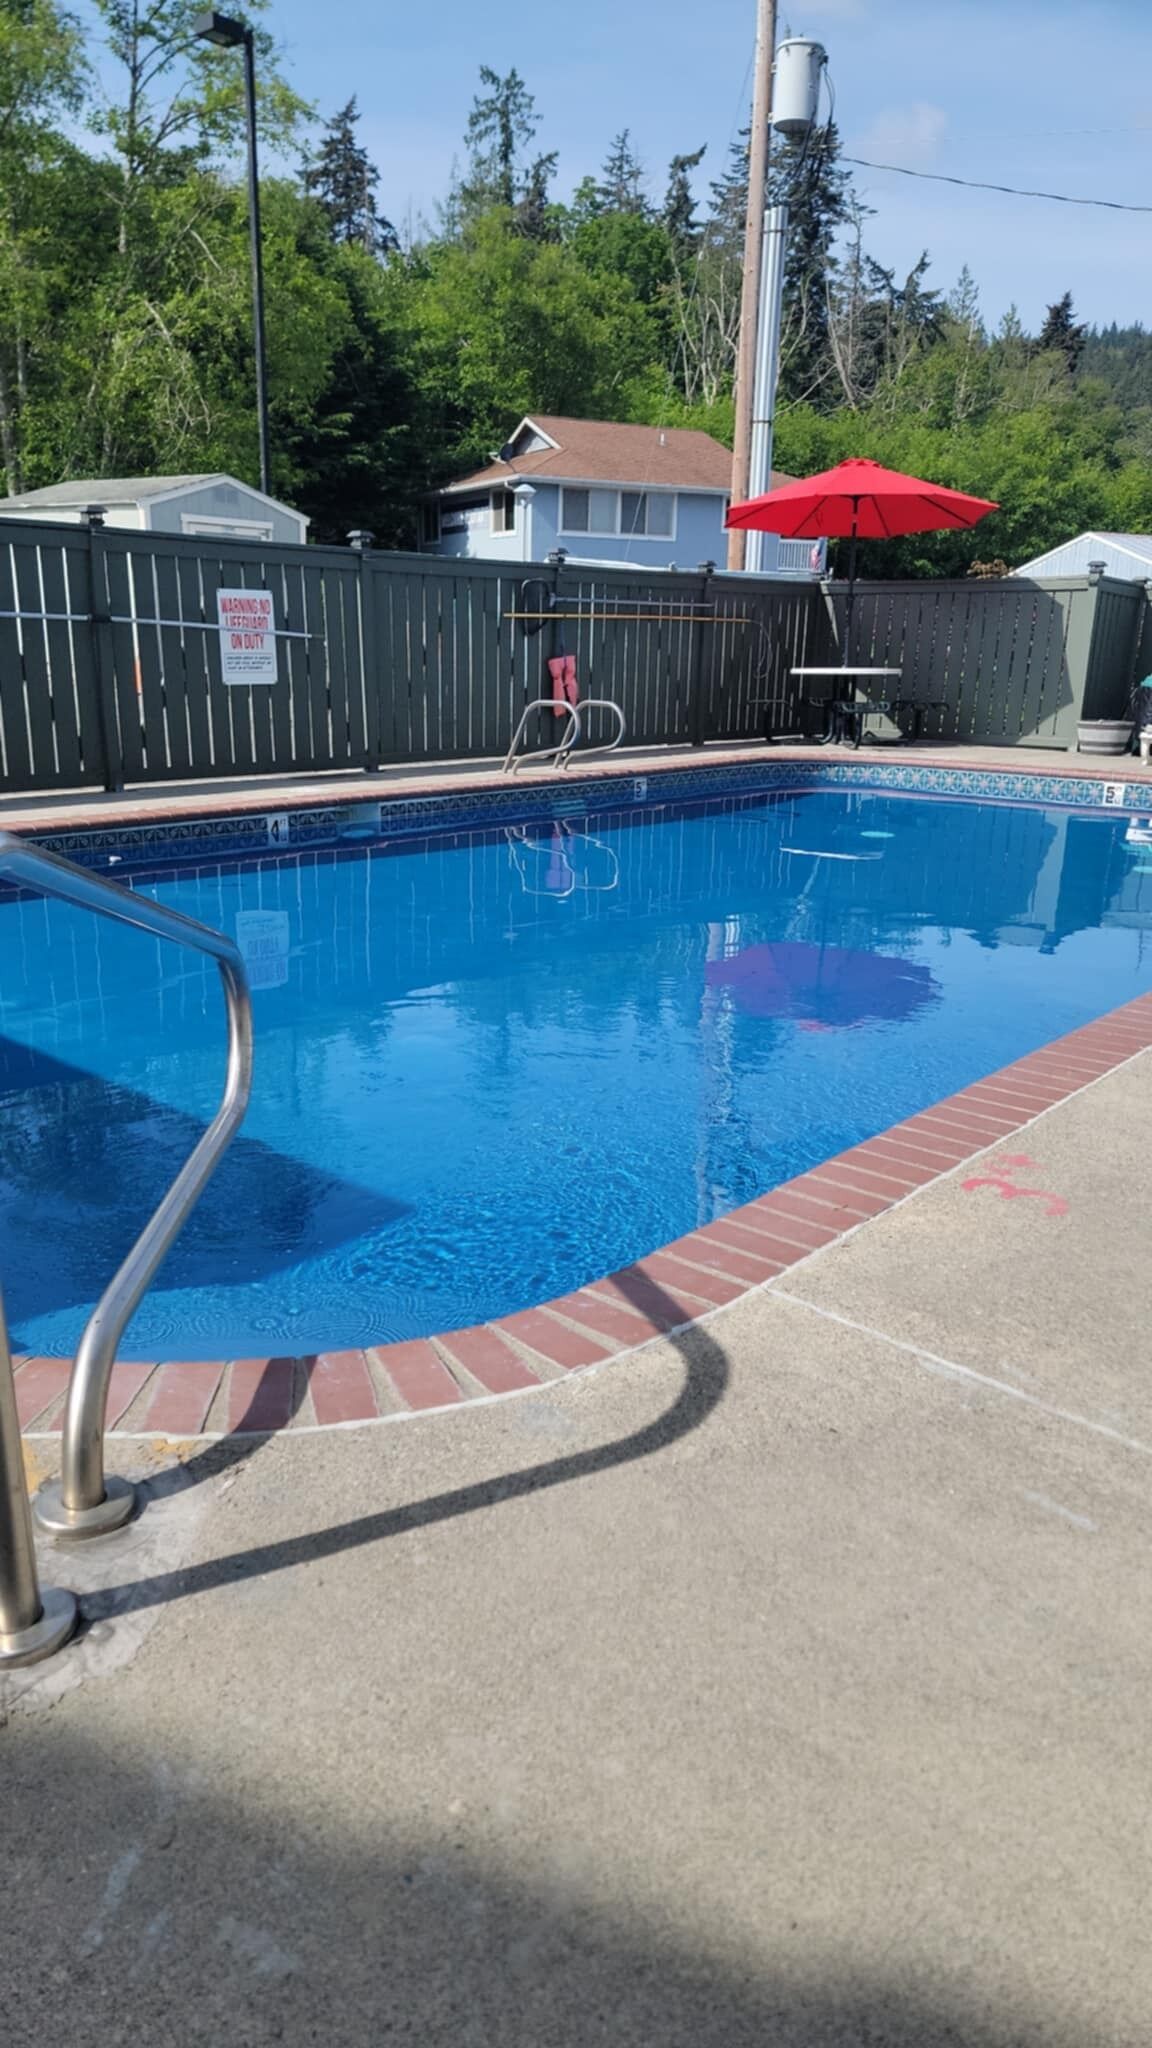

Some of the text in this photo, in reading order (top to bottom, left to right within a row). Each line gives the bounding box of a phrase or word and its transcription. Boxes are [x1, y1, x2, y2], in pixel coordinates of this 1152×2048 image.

[221, 598, 270, 615] WARNING NO
[225, 615, 268, 630] LIFEGUARD
[231, 633, 264, 649] ON DUTY
[636, 781, 642, 795] 5
